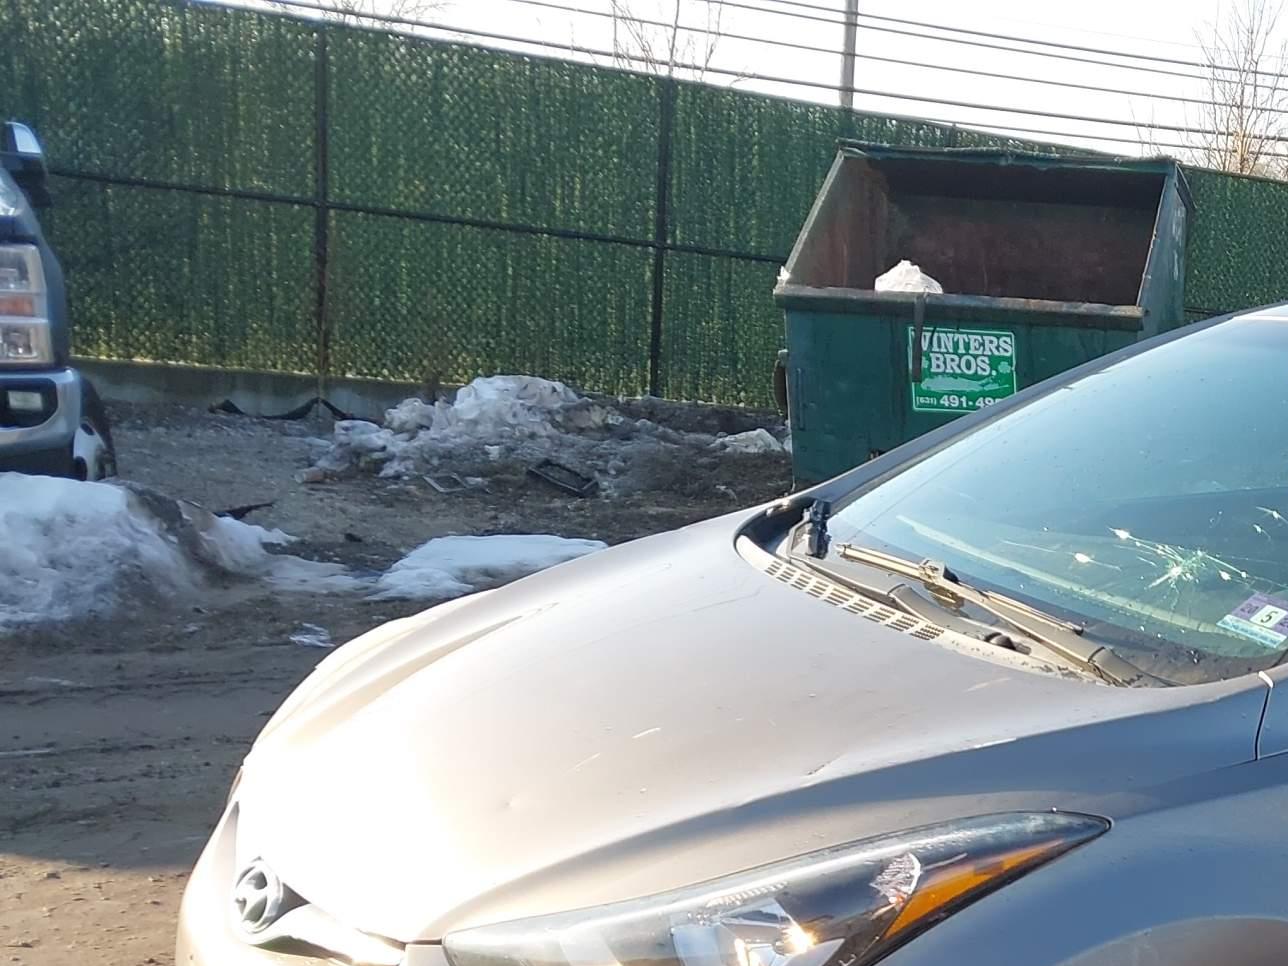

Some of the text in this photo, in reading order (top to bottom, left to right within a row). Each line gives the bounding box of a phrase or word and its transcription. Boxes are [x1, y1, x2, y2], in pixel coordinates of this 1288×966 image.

[929, 353, 997, 376] BROS.
[939, 394, 1003, 408] 491-49
[1261, 610, 1279, 624] 5
